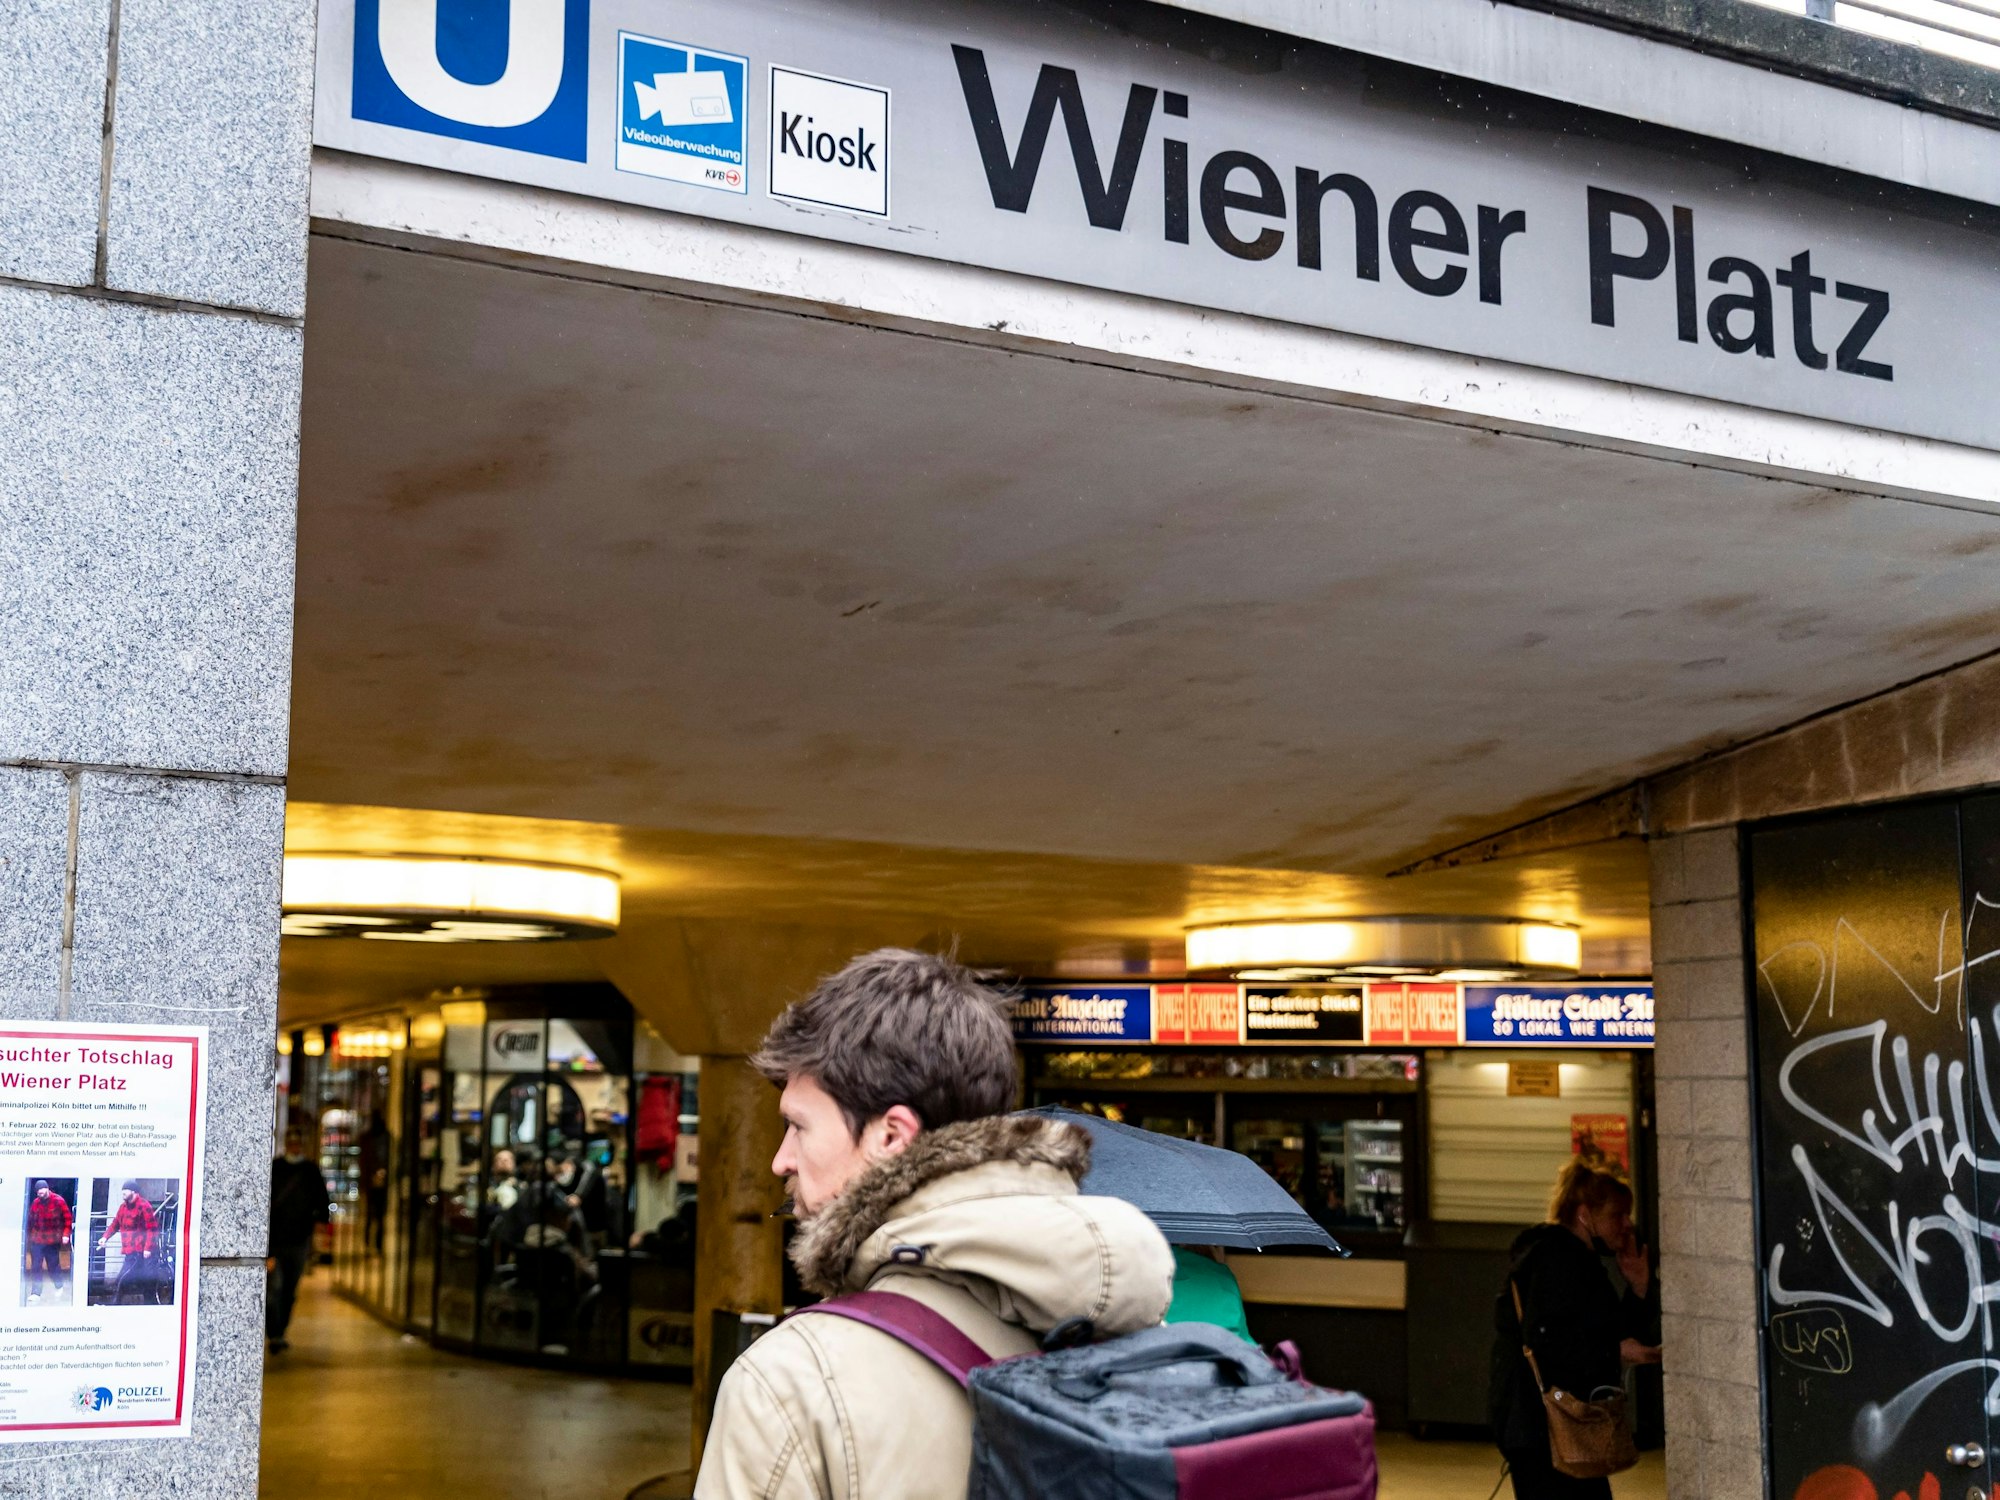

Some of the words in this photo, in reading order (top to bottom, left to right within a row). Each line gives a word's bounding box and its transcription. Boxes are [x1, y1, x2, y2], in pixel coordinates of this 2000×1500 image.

[624, 126, 741, 163] Videoüberwachung
[779, 110, 877, 173] Kiosk
[705, 169, 725, 180] KVB
[950, 43, 1526, 306] Wiener
[1586, 186, 1893, 382] Platz
[1190, 992, 1237, 1032] EXPRESS
[1409, 992, 1456, 1032] EXPRESS
[1492, 994, 1563, 1021] Kölner
[1033, 1020, 1124, 1034] INTERNATIONAL
[1493, 1020, 1513, 1036] SO
[1519, 1021, 1564, 1036] LOKAL
[1570, 1021, 1596, 1036] WIE
[78, 1048, 173, 1069] Totschlag
[1, 1073, 71, 1089] Wiener
[78, 1074, 127, 1090] Platz
[61, 1361, 113, 1369] Tatverdächtigen
[118, 1387, 163, 1396] POLIZEI
